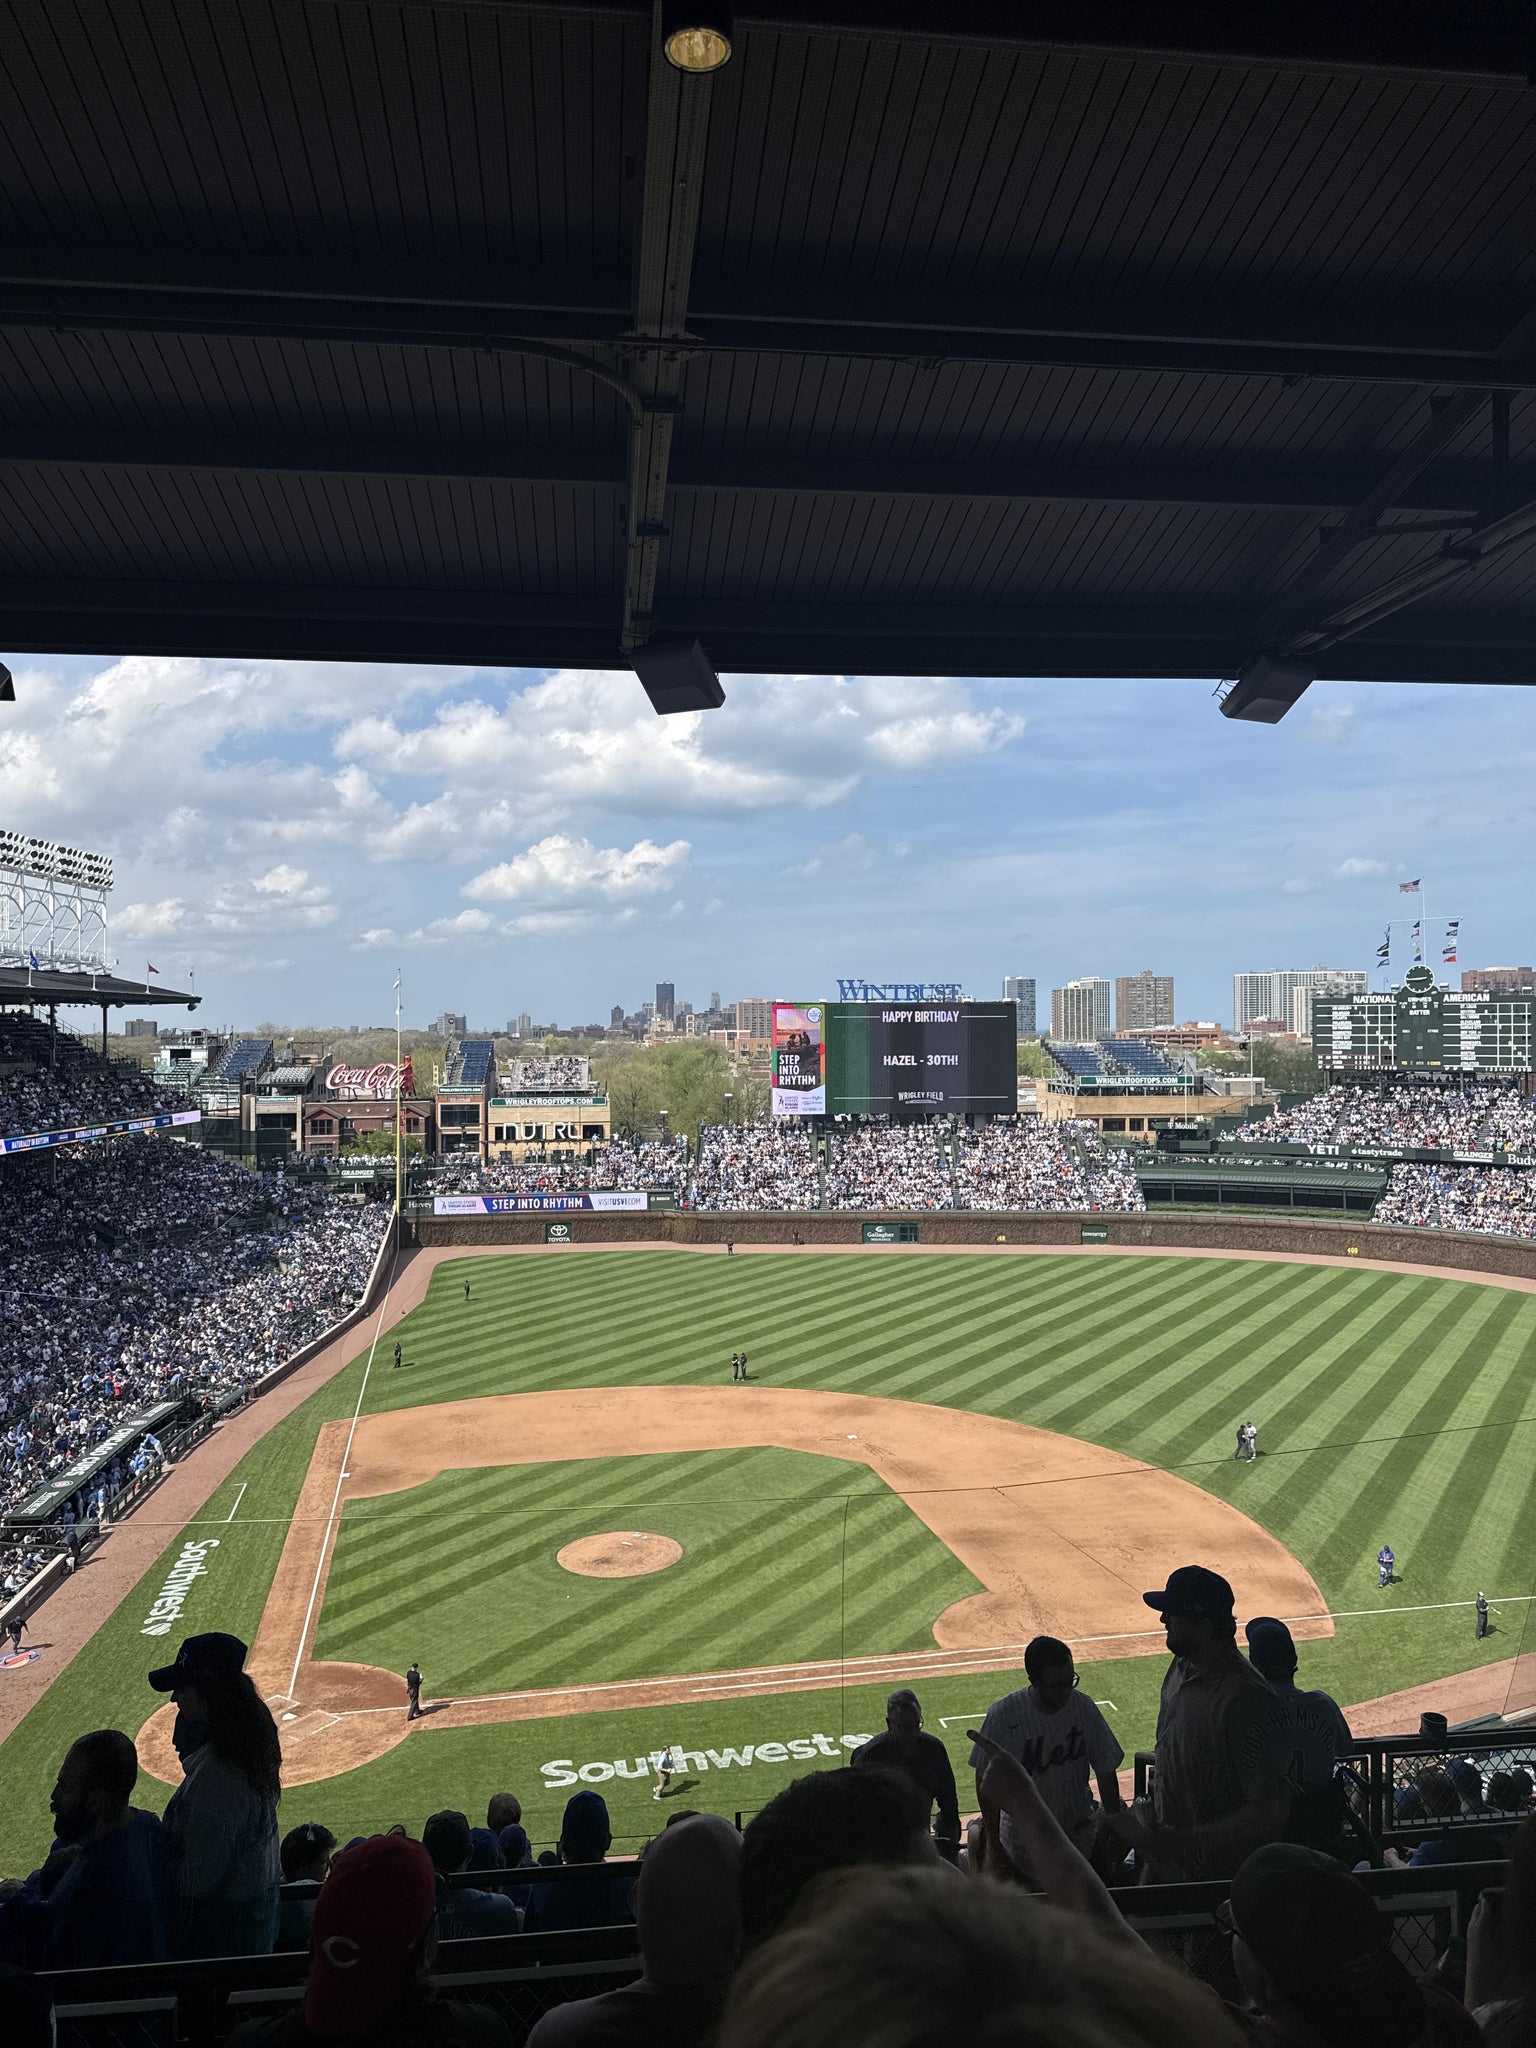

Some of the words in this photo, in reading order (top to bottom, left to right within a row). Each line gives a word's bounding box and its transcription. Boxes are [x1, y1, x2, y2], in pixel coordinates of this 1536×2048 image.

[836, 979, 962, 1001] WINTRUST
[1353, 995, 1397, 1003] NATIONAL
[1443, 993, 1490, 1002] AMERICAN
[882, 1010, 913, 1023] HAPPY
[914, 1010, 960, 1023] BIRTHDAY
[779, 1054, 800, 1065] STEP
[883, 1055, 917, 1066] HAZEL
[926, 1054, 959, 1066] 30TH!
[779, 1065, 800, 1075] INTO
[779, 1075, 816, 1086] RHYTHM
[1096, 1077, 1179, 1085] WRIGLEYROOFTOPS.COM
[505, 1097, 593, 1105] WRIGLEYROOFTOPS.COM
[898, 1091, 926, 1101] WRIGLEY
[926, 1091, 944, 1101] FIELD
[1175, 1122, 1198, 1130] Mobile
[1307, 1144, 1340, 1155] YETI
[1357, 1147, 1403, 1157] tastytrade
[1453, 1150, 1494, 1159] GRAINGER
[408, 1201, 433, 1209] Harvey
[492, 1200, 516, 1210] STEP
[517, 1199, 541, 1209] INTO
[543, 1197, 583, 1208] RHYTHM
[866, 1231, 895, 1239] Gallagher
[90, 1428, 135, 1456] CHICAGO
[143, 1539, 221, 1625] Southwest
[1021, 1726, 1086, 1776] Mets
